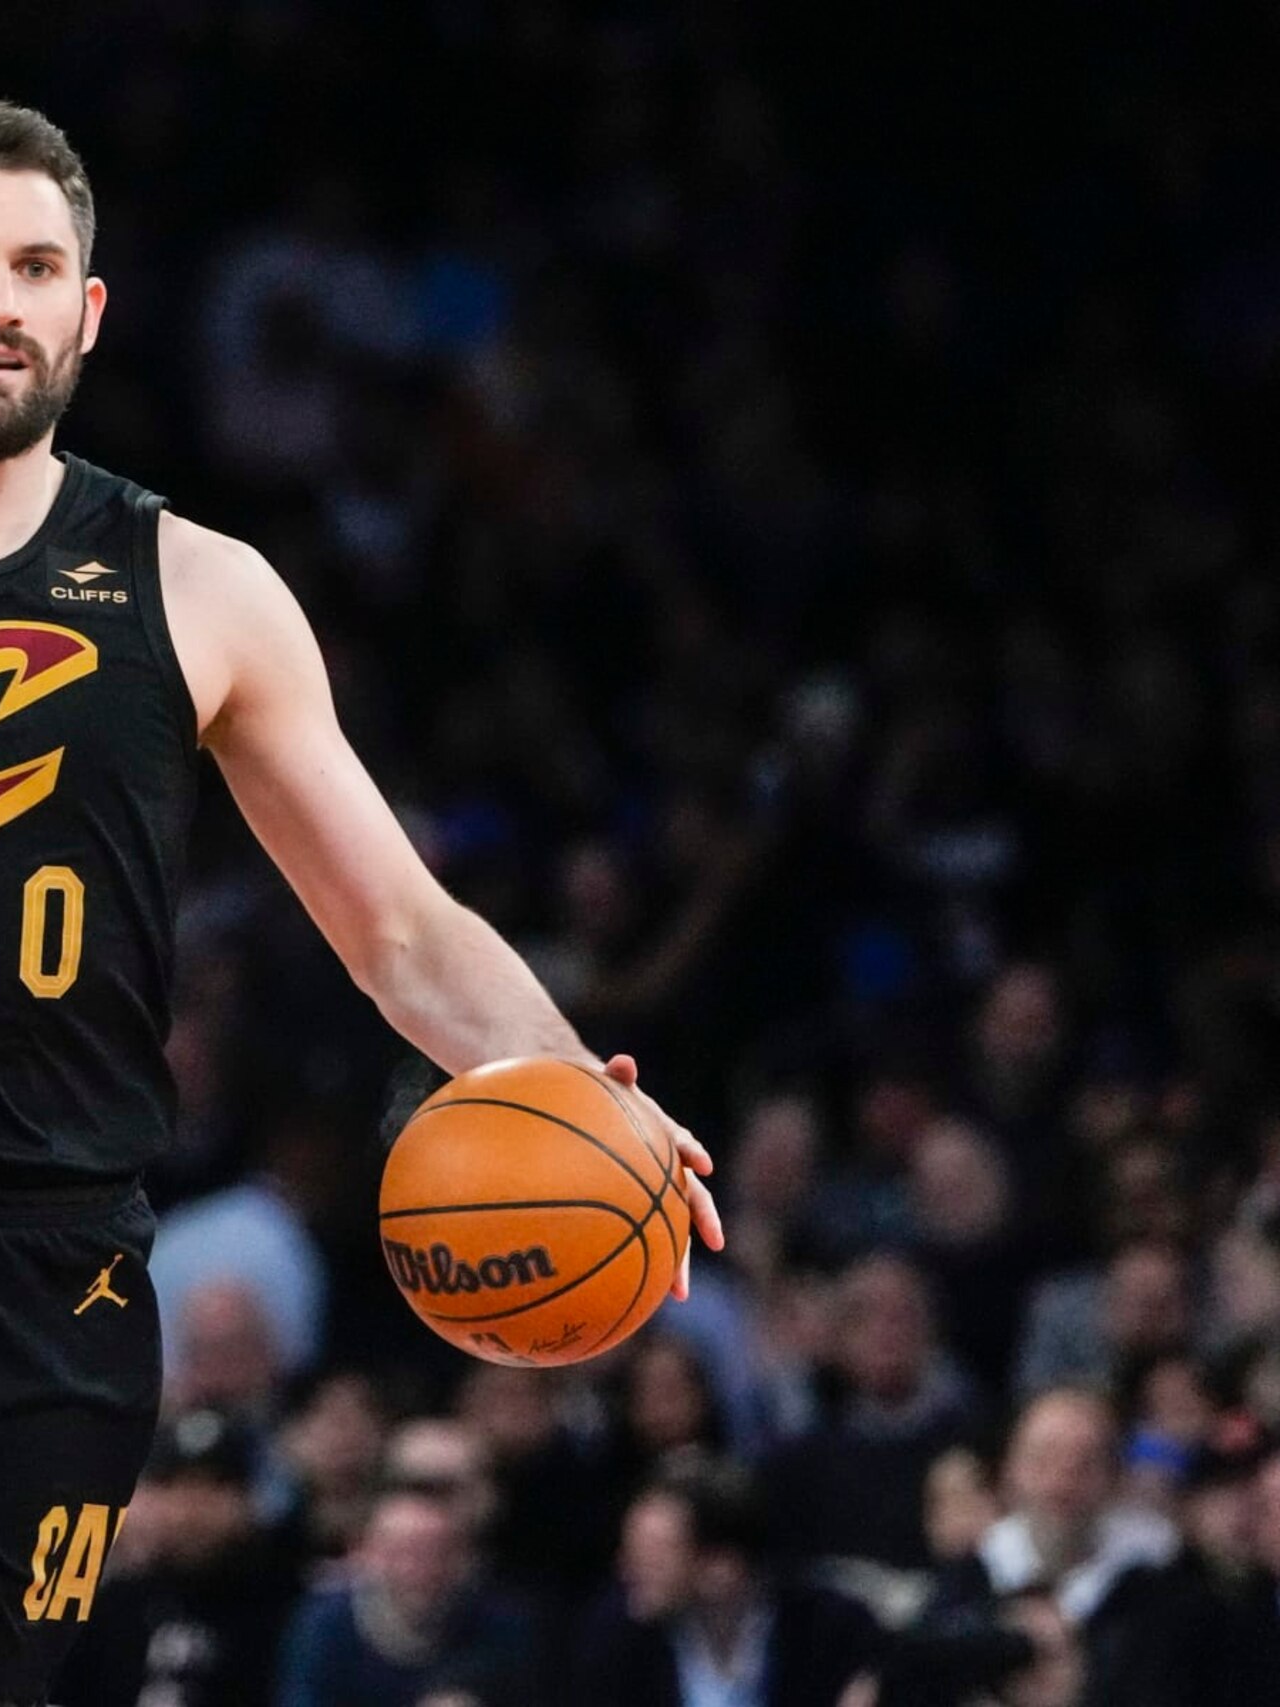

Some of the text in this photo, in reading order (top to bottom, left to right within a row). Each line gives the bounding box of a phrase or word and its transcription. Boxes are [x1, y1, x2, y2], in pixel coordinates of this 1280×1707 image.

[50, 586, 128, 604] CLIFFS
[19, 864, 86, 1000] 0
[384, 1239, 556, 1294] Wilson
[22, 1502, 128, 1623] CA
